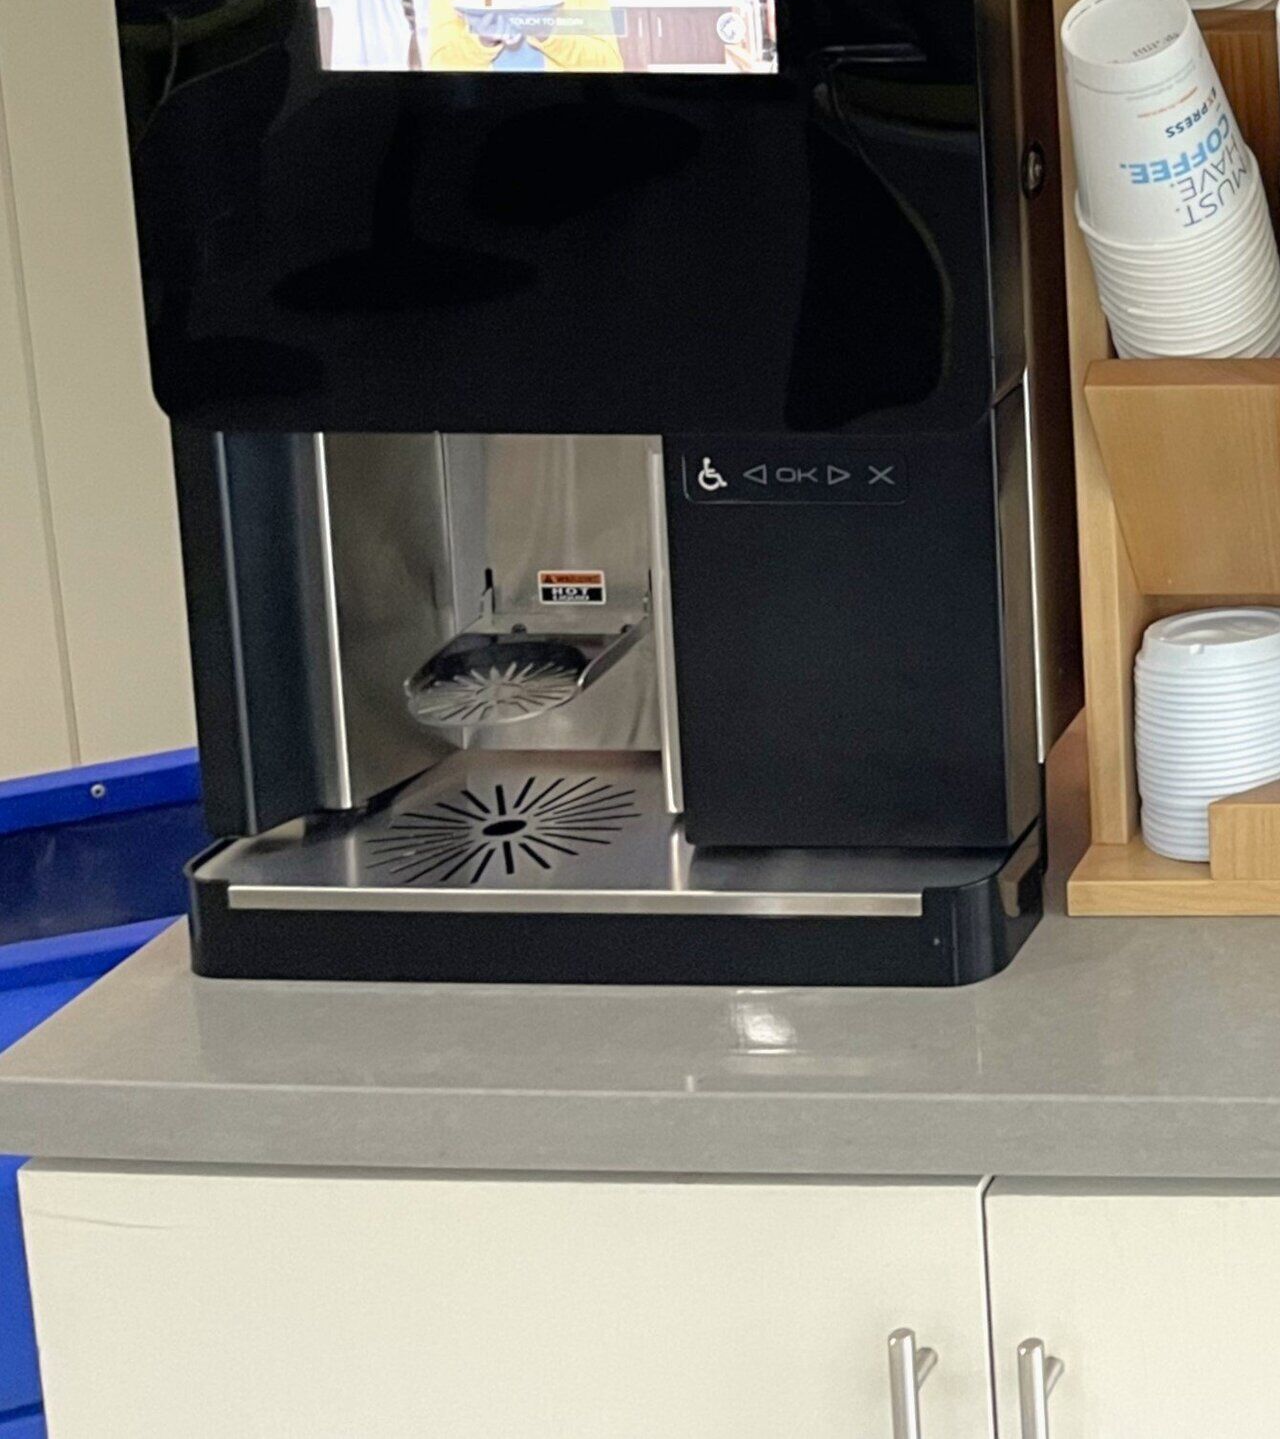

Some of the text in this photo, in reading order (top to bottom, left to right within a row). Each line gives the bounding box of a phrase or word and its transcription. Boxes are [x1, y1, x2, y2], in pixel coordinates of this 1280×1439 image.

[510, 17, 541, 26] TOUCH
[542, 18, 554, 26] TO
[1120, 114, 1229, 184] COFFEE.
[1170, 133, 1238, 202] HAVE.
[1176, 157, 1247, 227] MUST.
[775, 467, 818, 482] OK
[552, 587, 588, 595] HOT
